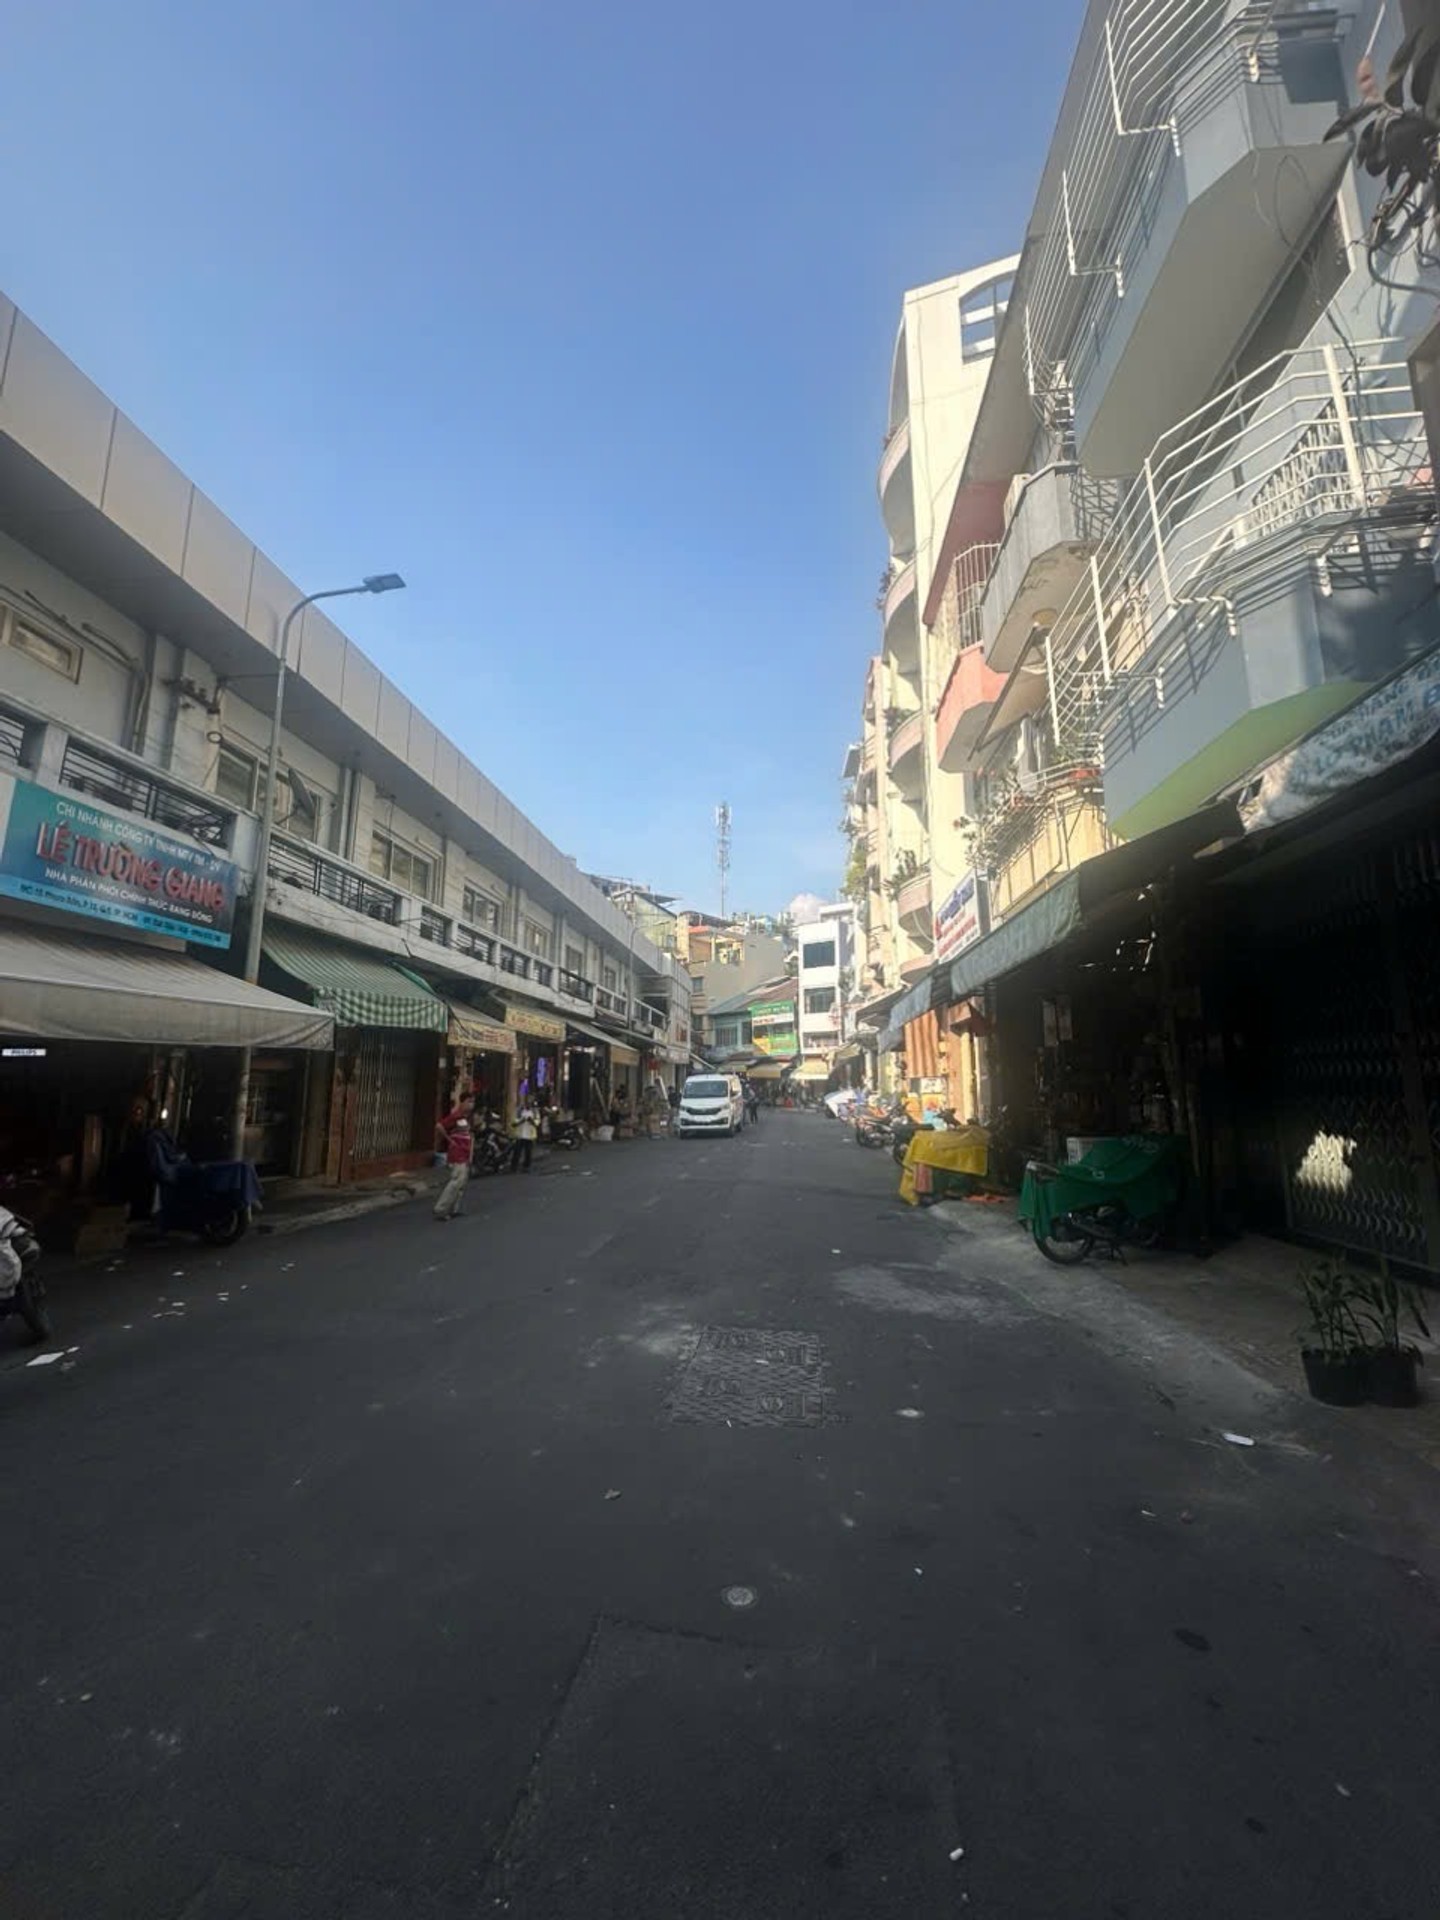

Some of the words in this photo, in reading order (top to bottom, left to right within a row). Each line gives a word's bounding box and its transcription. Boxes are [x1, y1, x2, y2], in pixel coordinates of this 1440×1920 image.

[56, 801, 76, 818] CHI
[114, 823, 143, 843] CÔNG
[74, 834, 161, 892] TRƯỜNG
[164, 866, 226, 912] GIANG
